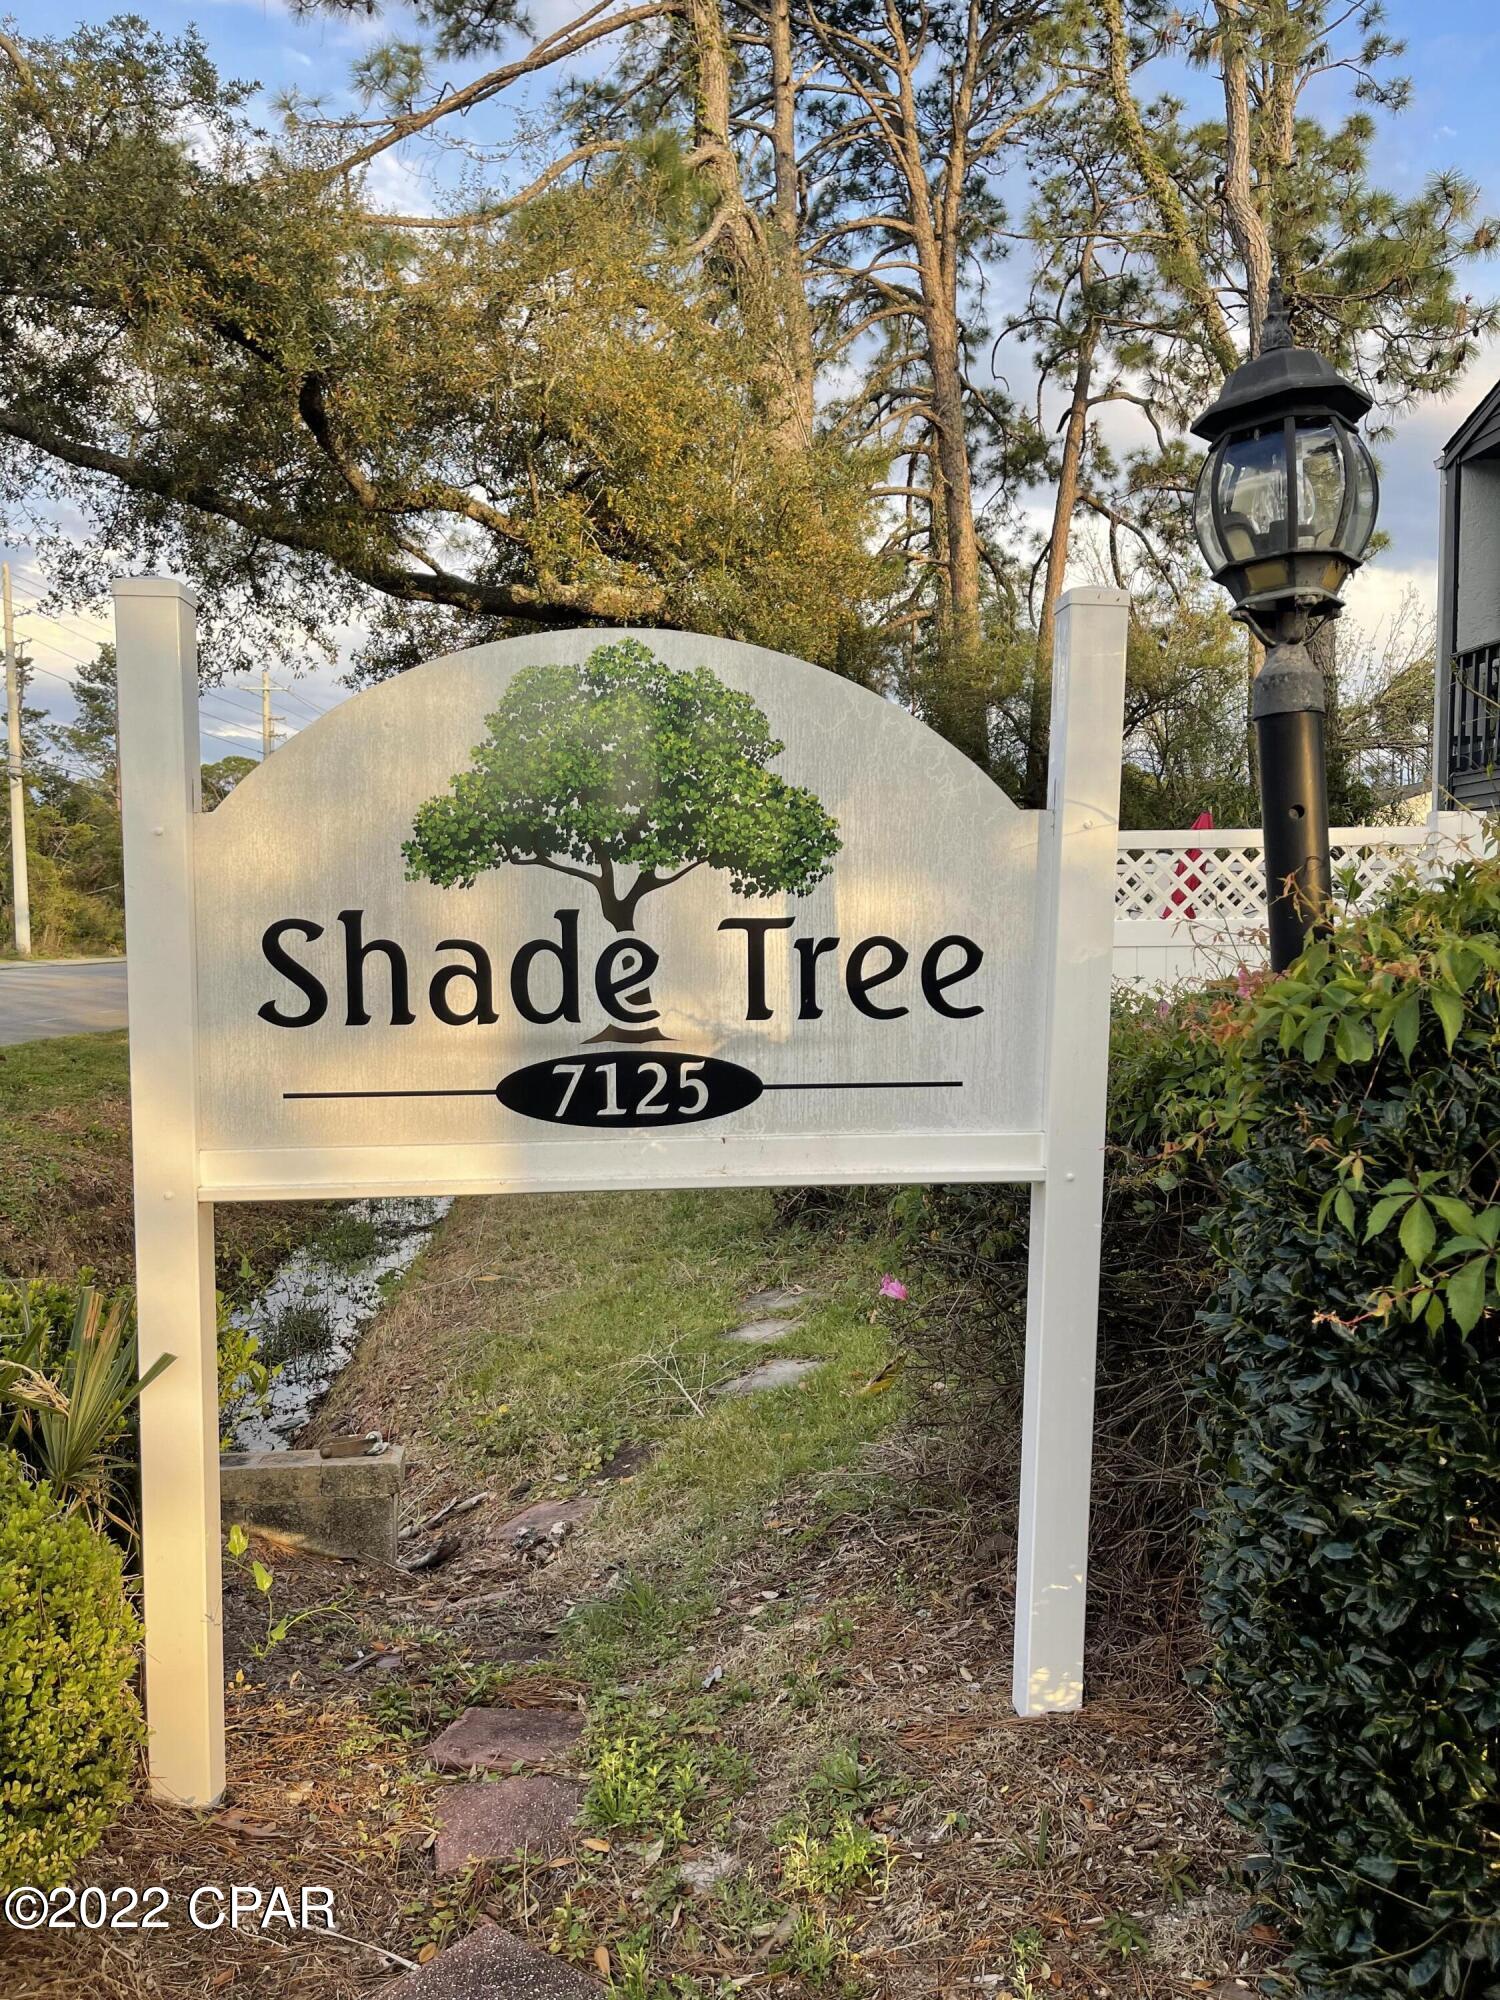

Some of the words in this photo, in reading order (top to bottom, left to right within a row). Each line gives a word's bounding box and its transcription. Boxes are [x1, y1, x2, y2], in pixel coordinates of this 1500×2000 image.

[257, 909, 662, 1028] Shade
[717, 915, 986, 1021] Tree
[551, 1060, 710, 1117] 7125
